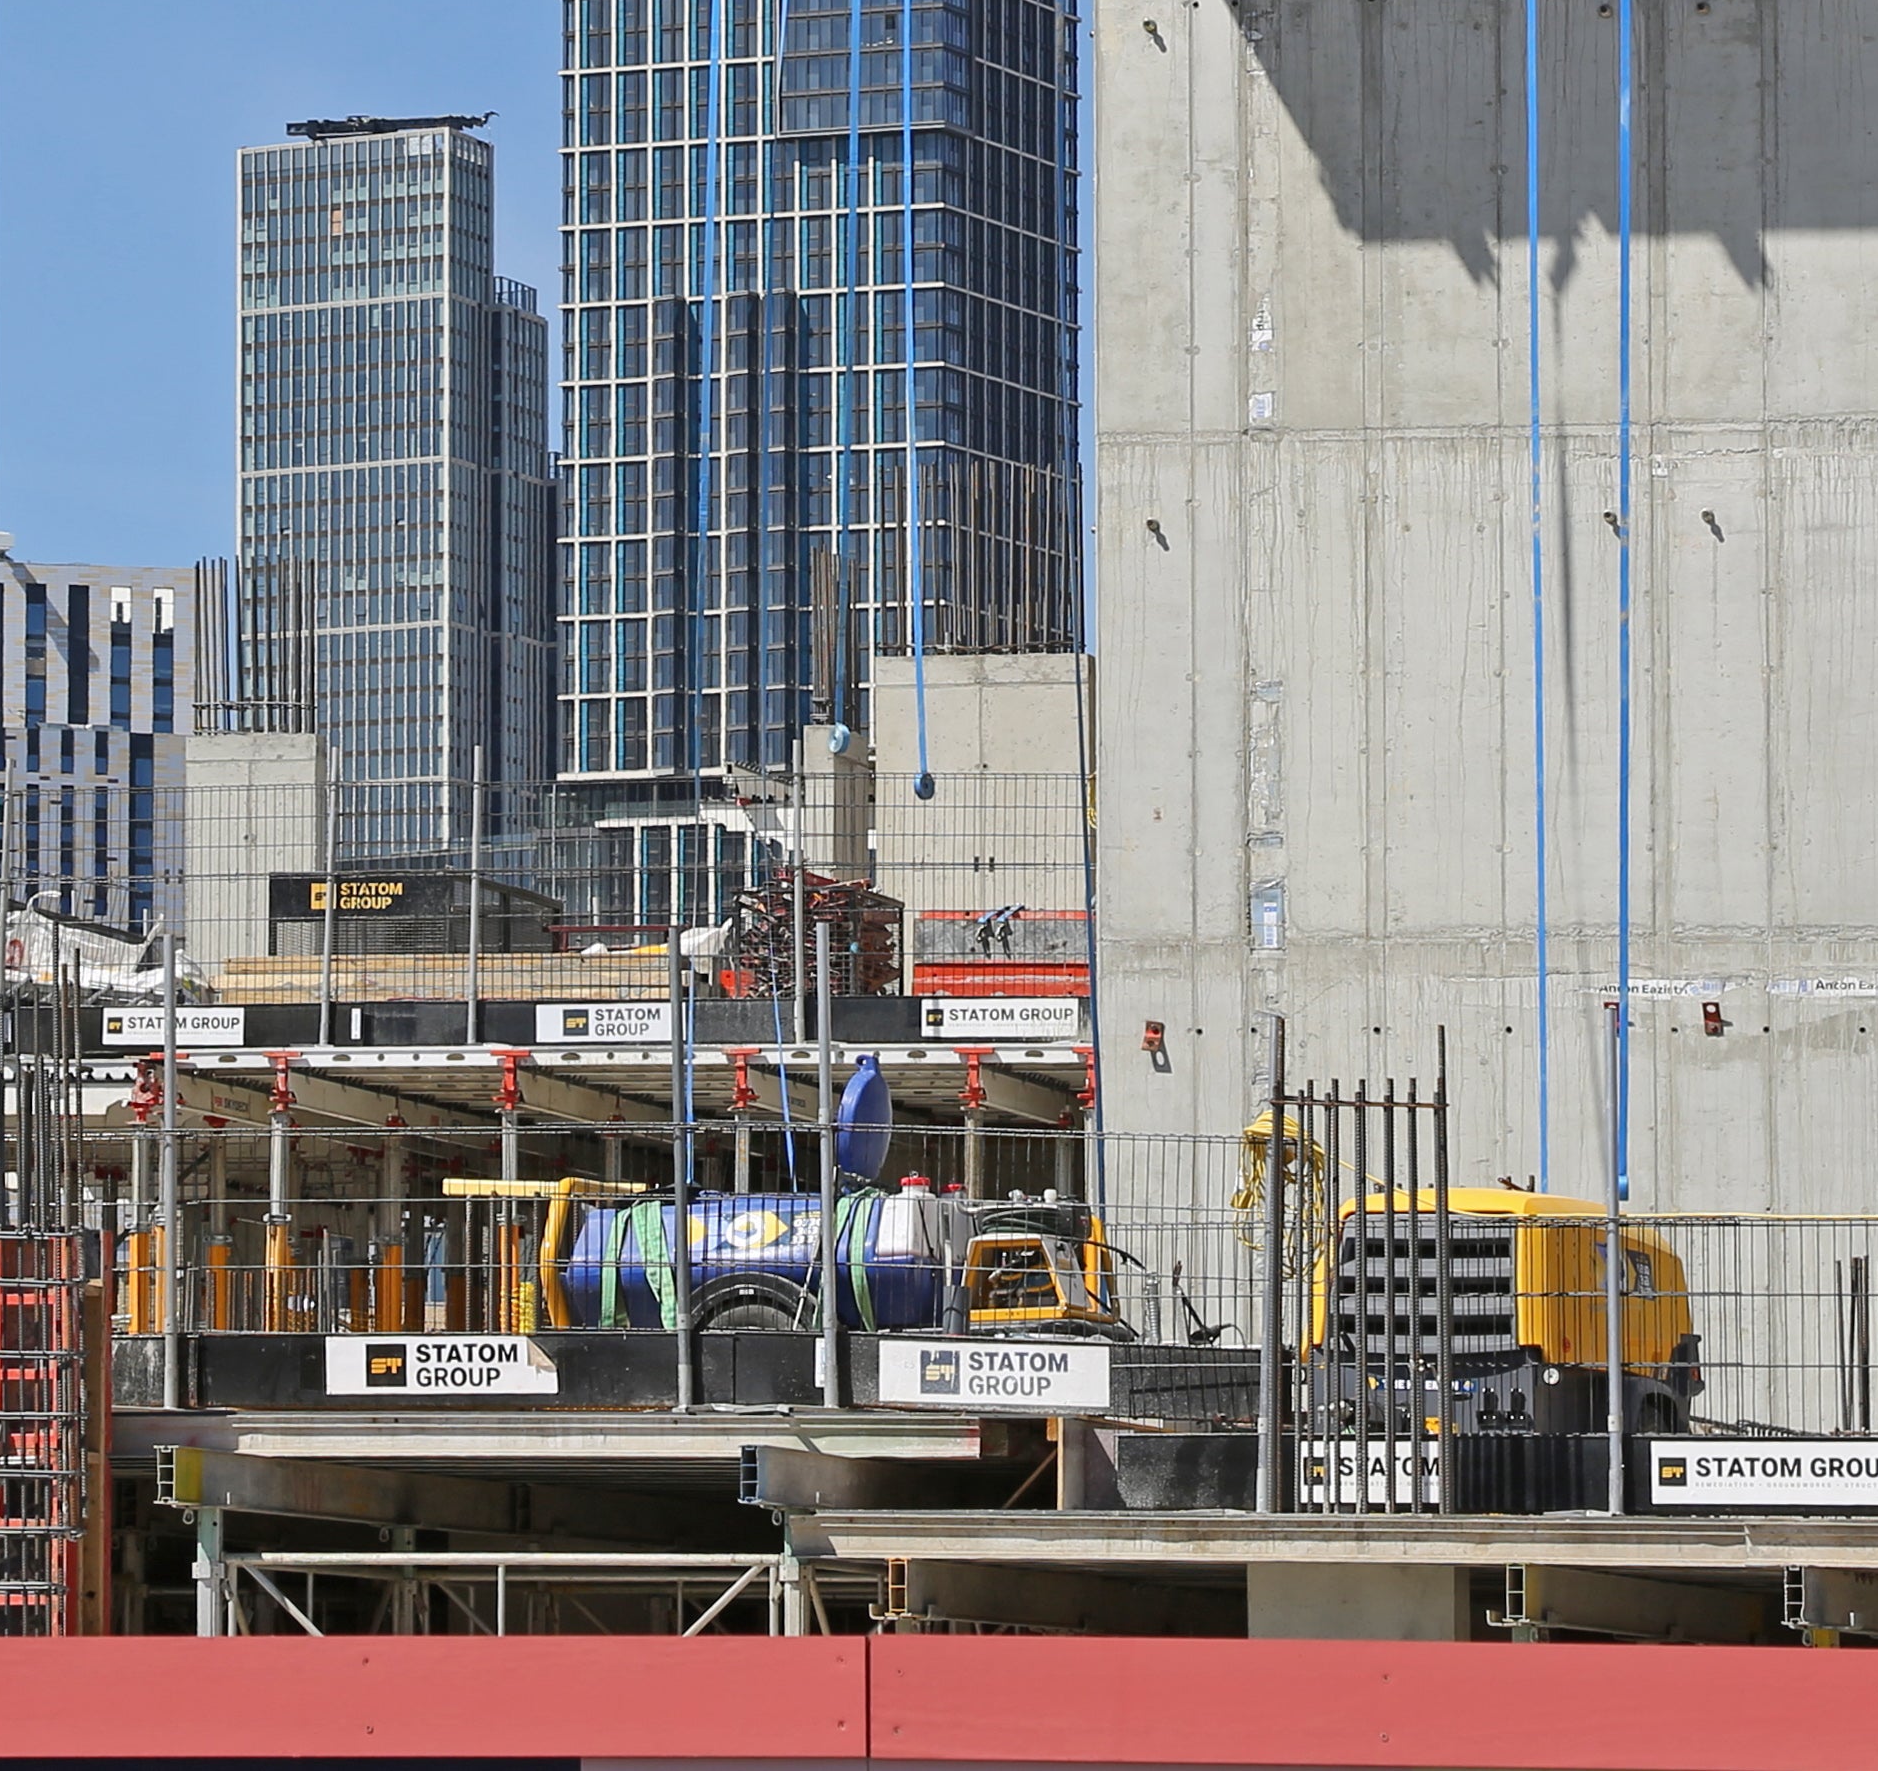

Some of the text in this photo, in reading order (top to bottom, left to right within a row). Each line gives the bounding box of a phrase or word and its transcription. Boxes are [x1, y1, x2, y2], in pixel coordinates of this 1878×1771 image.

[339, 882, 403, 896] STATOM
[339, 896, 393, 910] GROUP
[1815, 979, 1855, 991] Ancon
[594, 1008, 661, 1021] STATOM
[948, 1008, 1074, 1021] STATOM GROUP
[127, 1016, 240, 1029] STATM GROUP
[594, 1024, 650, 1037] GROUP
[416, 1343, 519, 1364] STATOM
[968, 1351, 1069, 1373] STATOM
[416, 1367, 501, 1387] GROUP
[968, 1375, 1052, 1397] GROUP
[1695, 1457, 1802, 1479] STATOM
